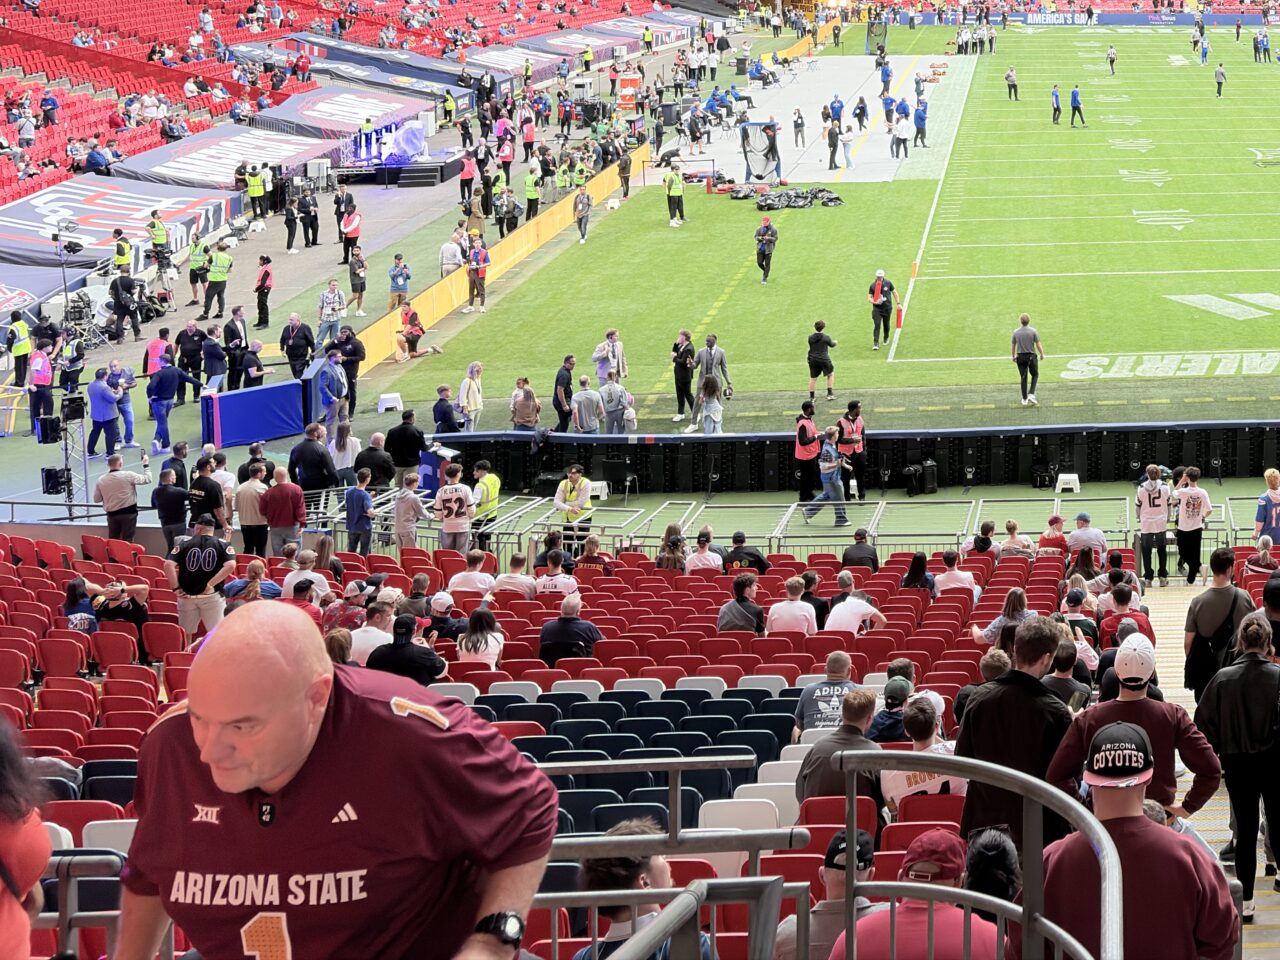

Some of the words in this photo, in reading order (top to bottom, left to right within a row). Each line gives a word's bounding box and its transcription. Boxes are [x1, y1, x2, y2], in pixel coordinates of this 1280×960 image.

[1027, 13, 1072, 25] AMERICA'S
[1074, 13, 1099, 25] GAE
[1132, 208, 1194, 225] 10
[442, 497, 466, 518] 52
[1148, 491, 1161, 508] 12
[186, 548, 217, 572] 00
[813, 686, 850, 698] ADIDA
[1101, 742, 1137, 751] ARIZONA
[1093, 750, 1145, 770] COYOTES
[170, 871, 280, 905] ARIZONA
[287, 869, 368, 905] STATE
